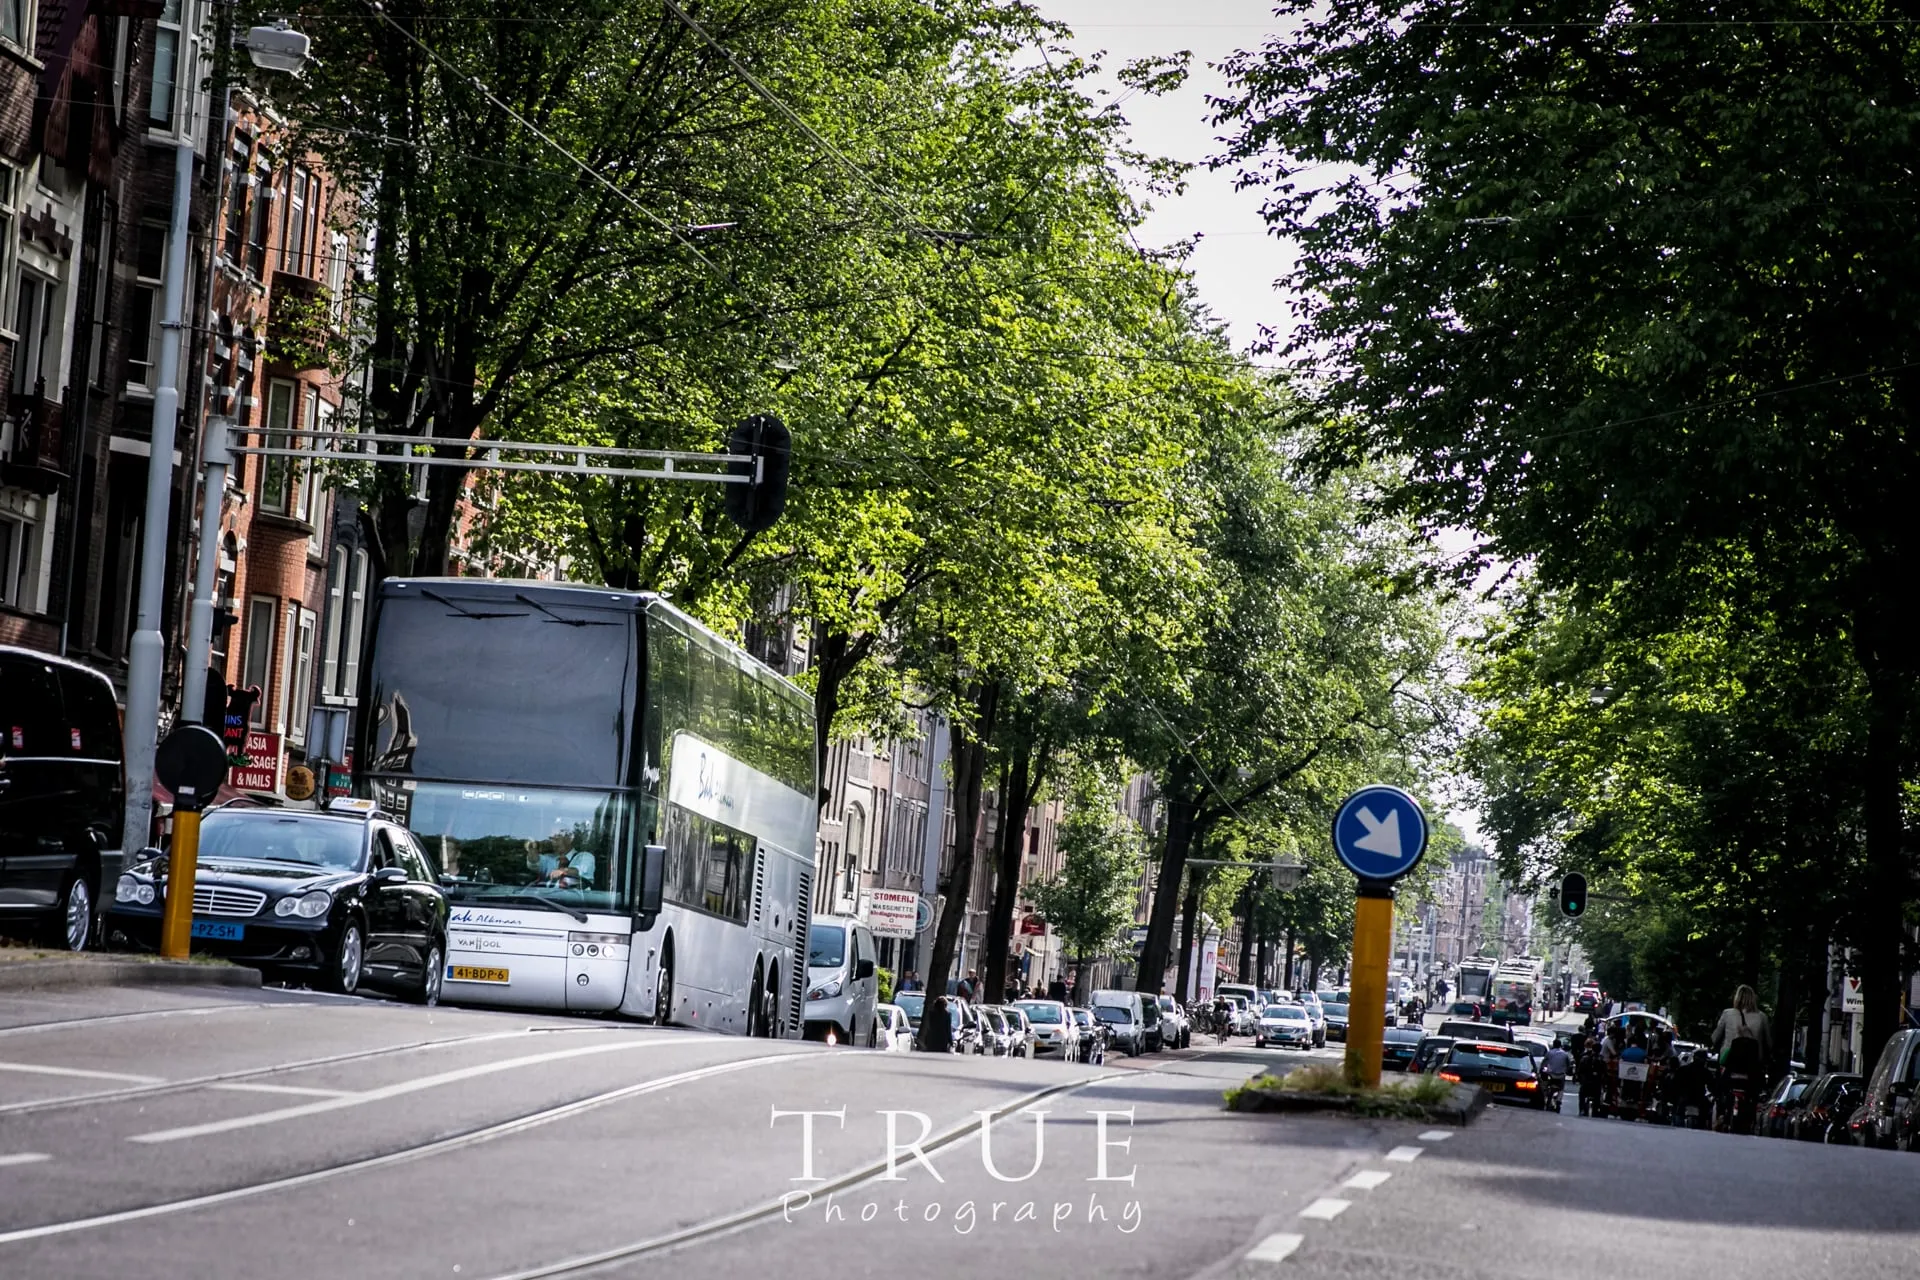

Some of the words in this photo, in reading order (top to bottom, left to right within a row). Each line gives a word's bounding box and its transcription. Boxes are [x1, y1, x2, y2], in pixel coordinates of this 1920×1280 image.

[246, 736, 267, 751] ASIA
[248, 754, 277, 770] SSAGE
[236, 773, 245, 786] &
[245, 773, 271, 788] NAILS
[873, 892, 915, 904] STOMERIJ
[451, 909, 473, 923] ak
[191, 922, 236, 938] -PZ-SH
[457, 968, 505, 981] 41-BDP-6
